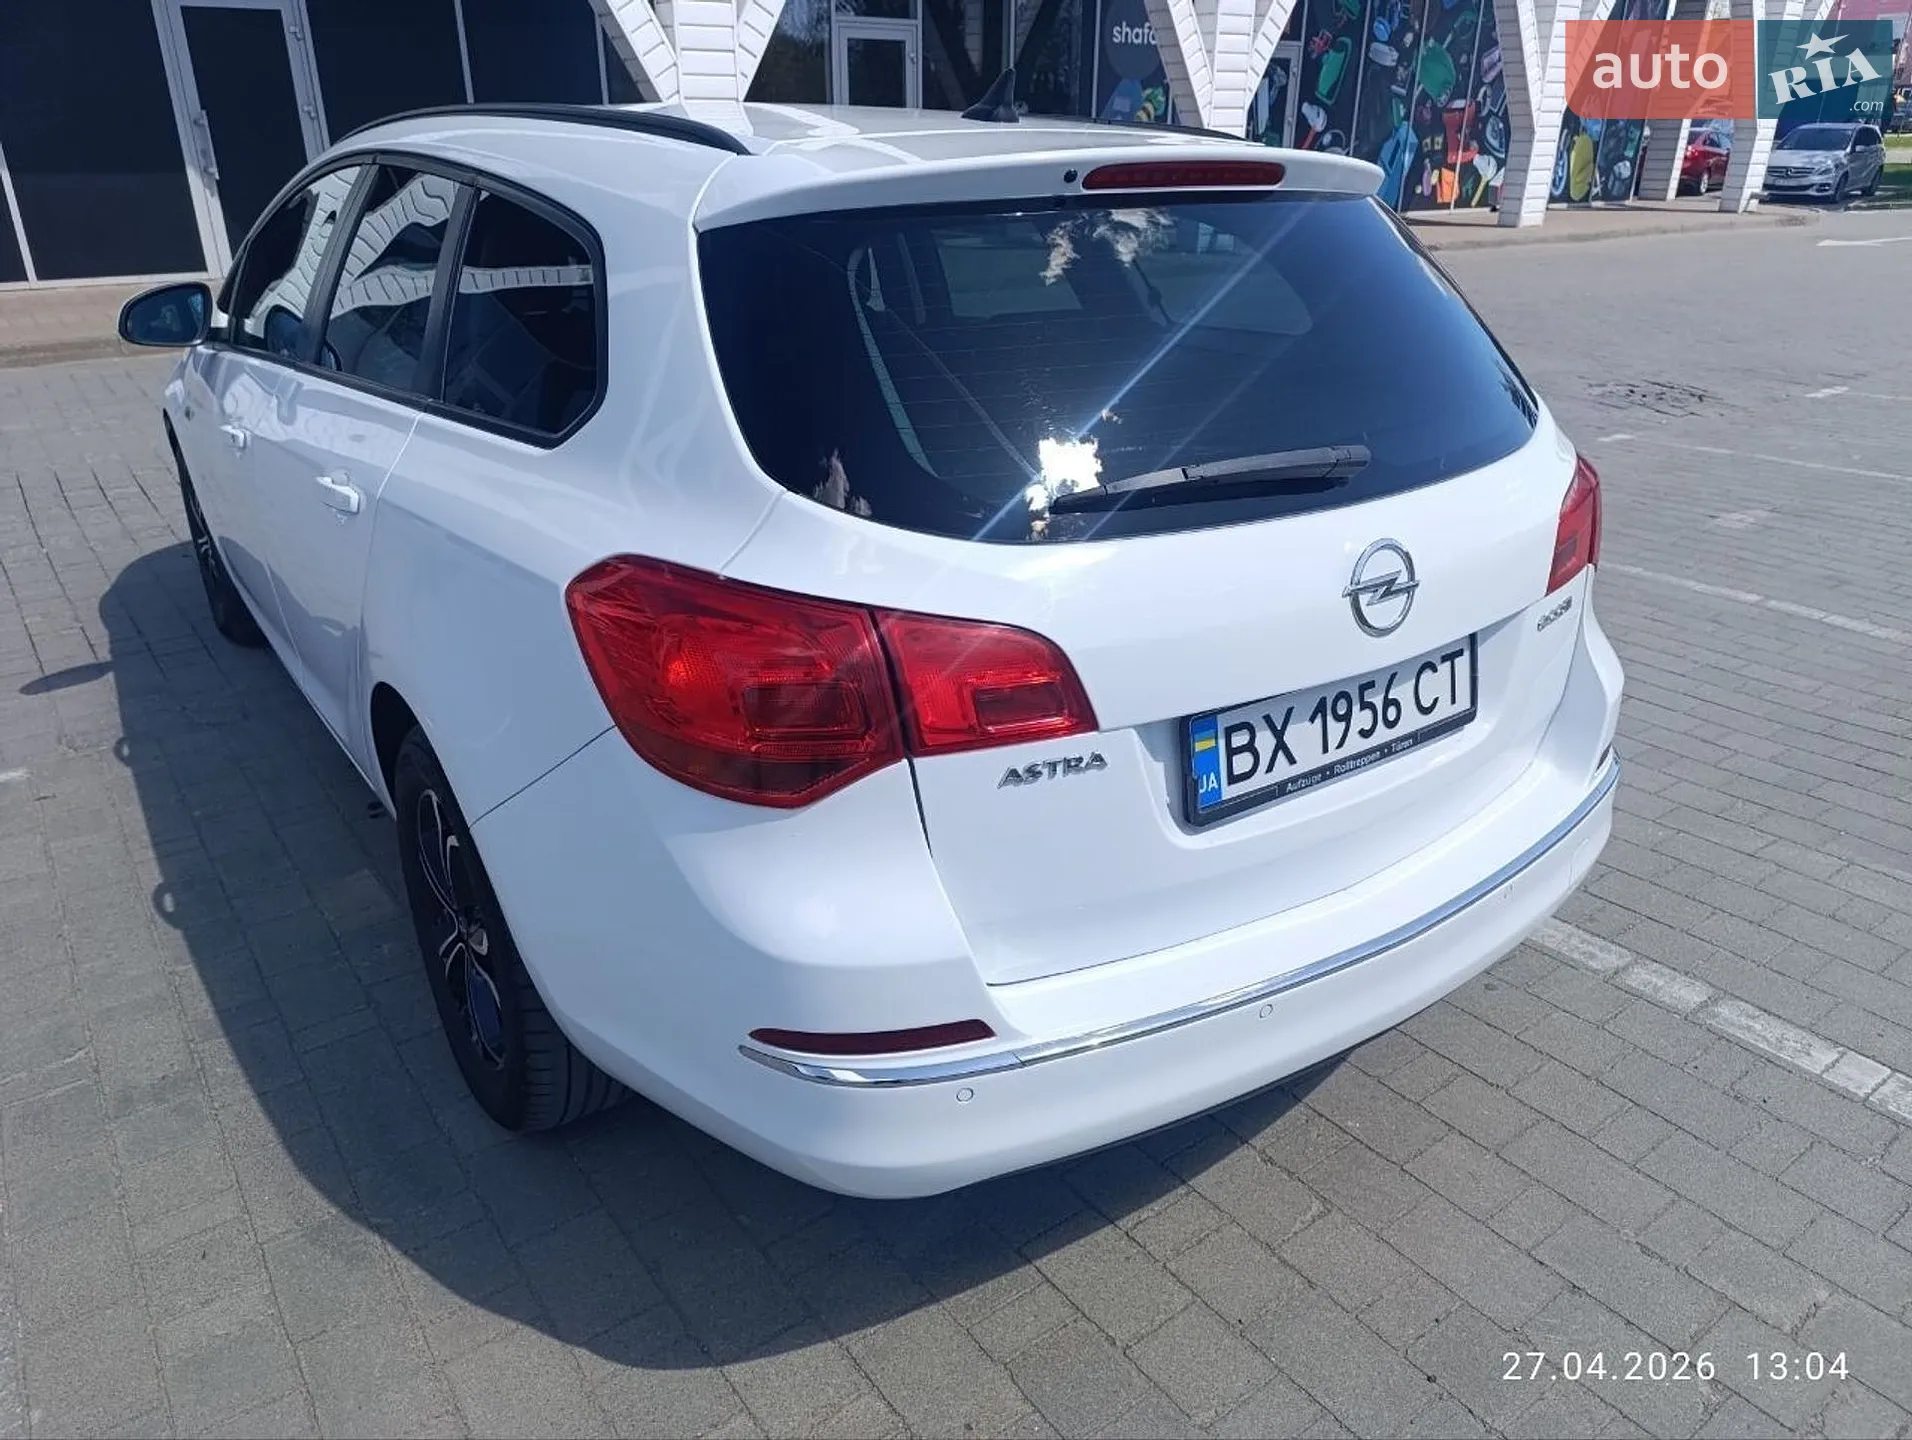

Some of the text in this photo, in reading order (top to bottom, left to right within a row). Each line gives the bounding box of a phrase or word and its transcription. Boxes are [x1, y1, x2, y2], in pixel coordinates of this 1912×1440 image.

[1224, 648, 1465, 787] BX 1956 CT
[997, 751, 1108, 789] ASTRA
